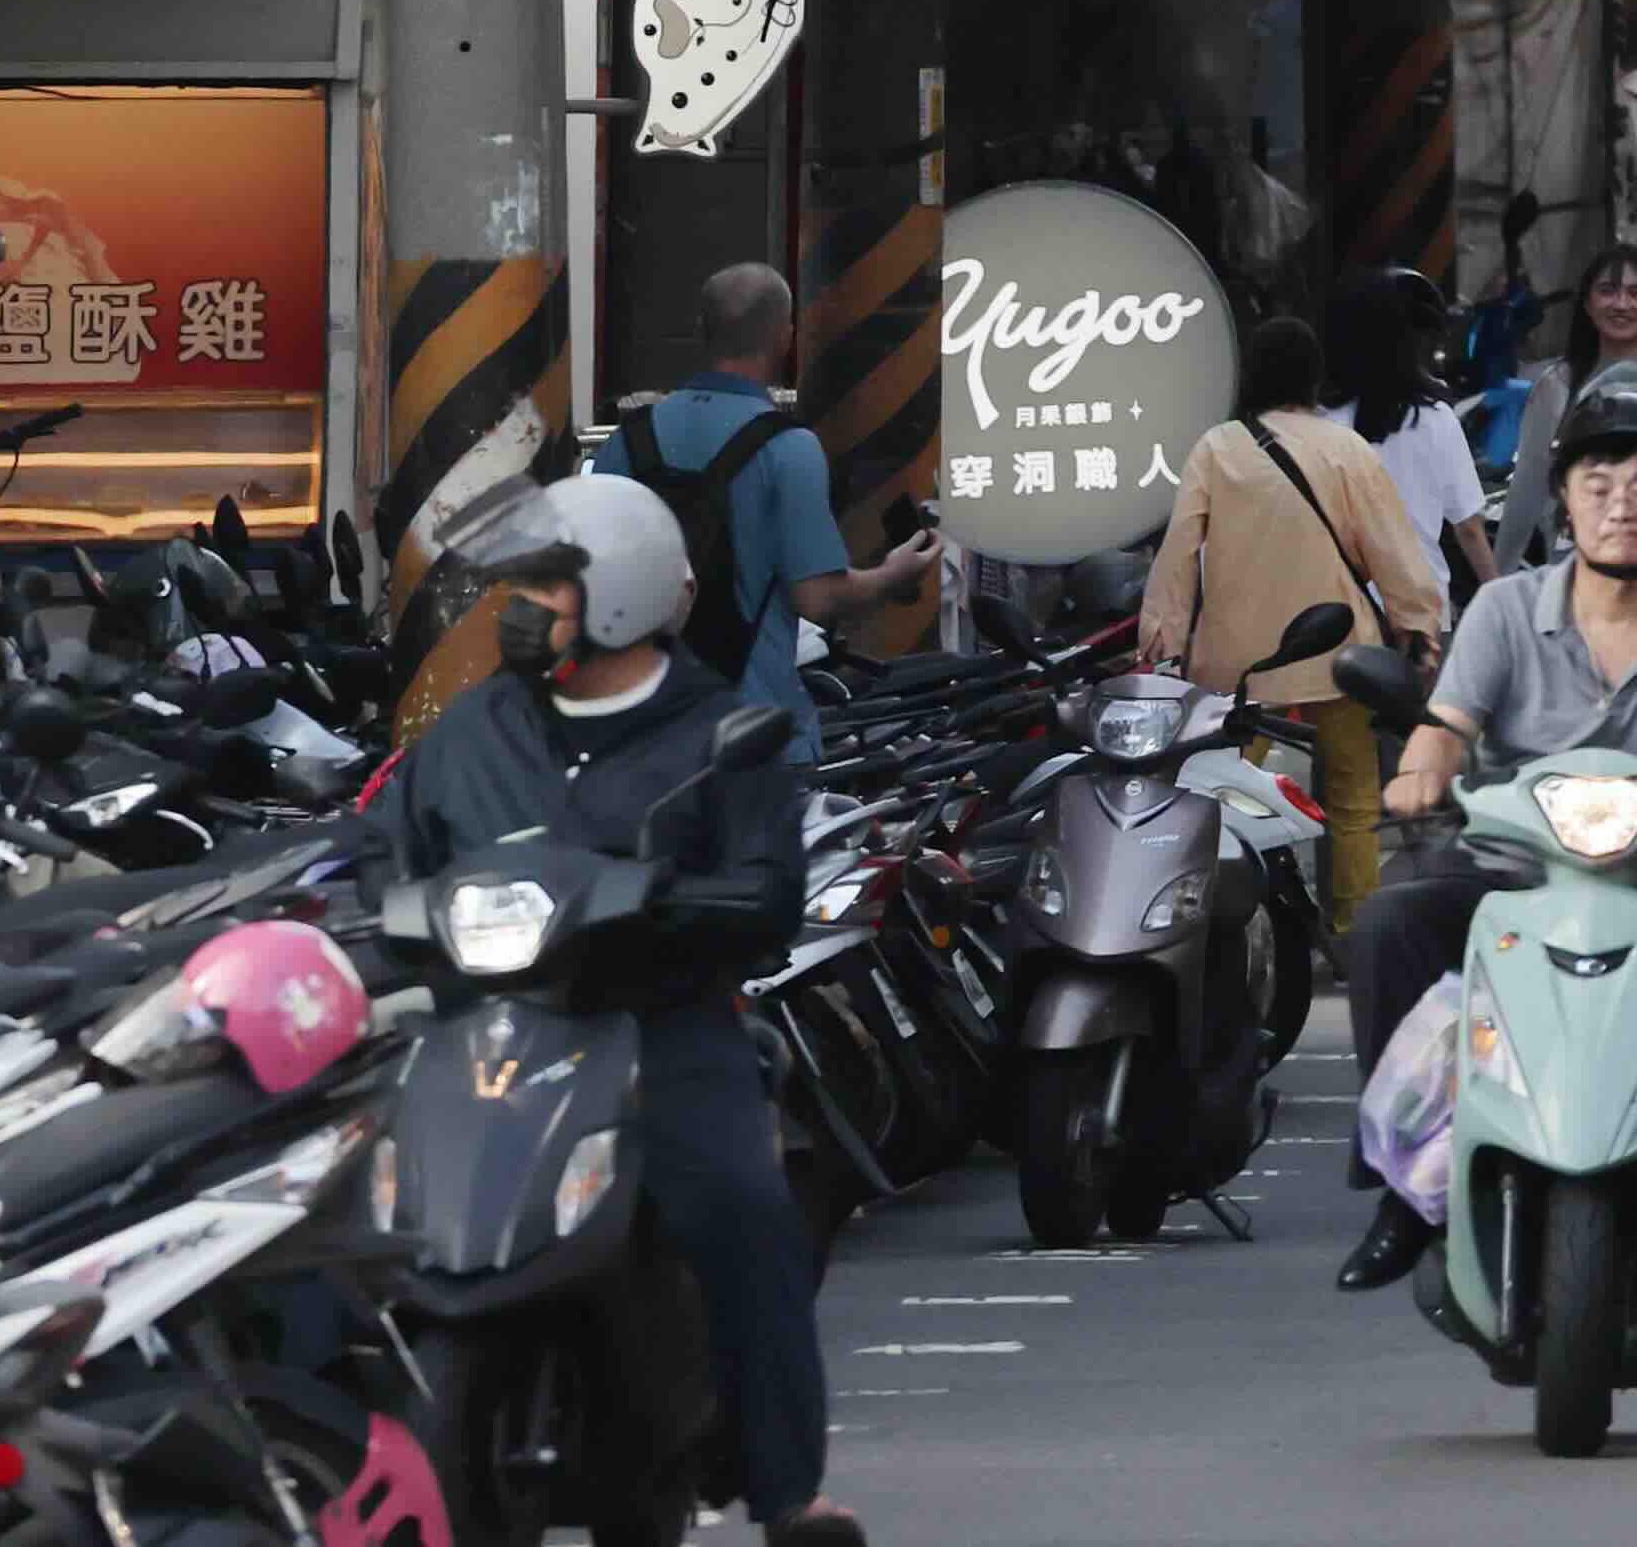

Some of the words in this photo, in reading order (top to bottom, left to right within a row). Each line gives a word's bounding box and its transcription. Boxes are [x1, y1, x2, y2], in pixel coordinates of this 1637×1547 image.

[940, 258, 1205, 431] Yugoo
[949, 443, 1182, 500] 穿洞職人
